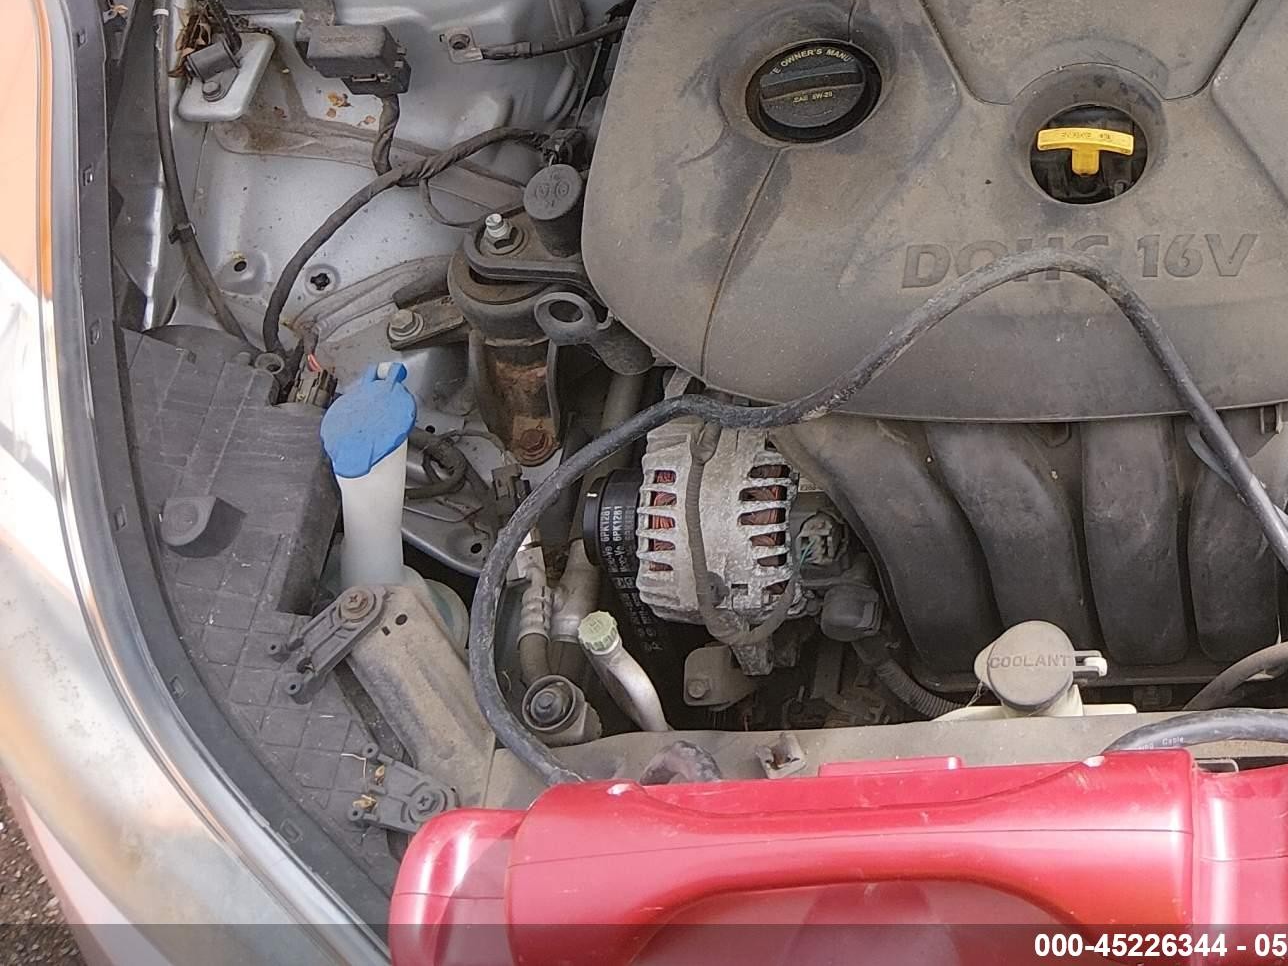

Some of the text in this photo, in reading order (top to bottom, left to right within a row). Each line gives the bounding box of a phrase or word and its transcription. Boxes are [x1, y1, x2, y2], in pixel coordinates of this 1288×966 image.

[780, 48, 823, 67] OWNER'S
[1136, 233, 1258, 278] 16V
[612, 505, 623, 542] 6PK1281
[989, 654, 1072, 669] COOLANT
